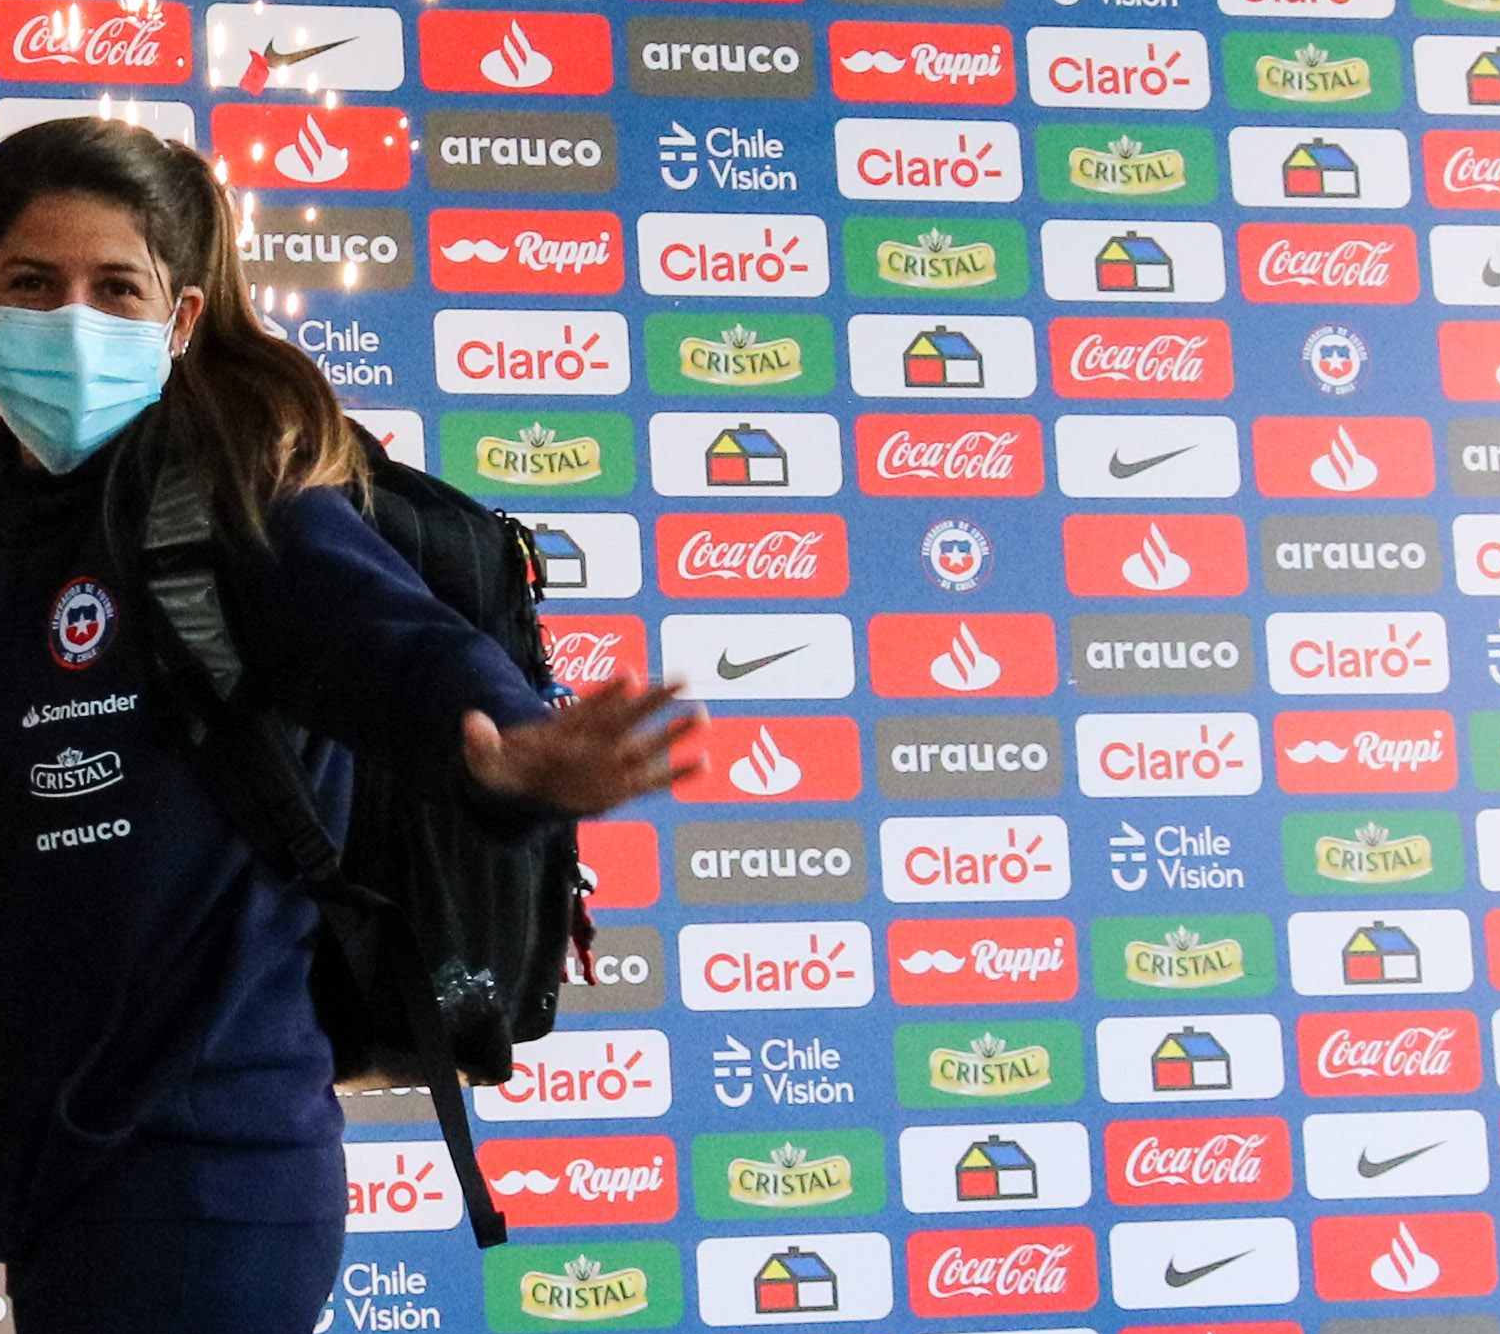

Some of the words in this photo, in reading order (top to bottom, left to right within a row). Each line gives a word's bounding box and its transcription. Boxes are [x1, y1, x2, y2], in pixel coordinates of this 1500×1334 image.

[641, 41, 800, 74] arauco
[910, 42, 1004, 85] Rappi
[1048, 56, 1168, 95] Claro
[1266, 66, 1360, 91] CRISTAL
[440, 135, 602, 168] arauco
[705, 126, 784, 158] Chile
[856, 148, 980, 187] Claro
[1078, 158, 1174, 184] CRISTAL
[514, 230, 612, 273] Rappi
[659, 243, 785, 282] Claro
[887, 252, 985, 277] CRISTAL
[1255, 238, 1397, 288] Coca-Cola
[297, 319, 379, 352] Chile
[456, 340, 585, 379] Claro
[690, 348, 790, 374] CRISTAL
[1067, 333, 1212, 382] Coca-Cola
[486, 447, 589, 473] CRISTAL
[874, 430, 1021, 479] Coca-Cola
[675, 530, 825, 580] Coca-Cola
[1274, 541, 1426, 570] arauco
[1084, 640, 1240, 670] arauco
[1289, 640, 1409, 678] Claro
[41, 693, 138, 724] Santander
[890, 741, 1048, 773] arauco
[1099, 741, 1221, 780] Claro
[1353, 729, 1446, 772] Rappi
[36, 761, 113, 790] CRISTAL
[37, 818, 131, 852] arauco
[1153, 824, 1231, 857] Chile
[689, 846, 851, 879] arauco
[903, 845, 1029, 885] Claro
[1325, 845, 1421, 872] CRISTAL
[703, 951, 831, 993] Claro
[970, 937, 1066, 982] Rappi
[1134, 950, 1232, 977] CRISTAL
[760, 1037, 841, 1071] Chile
[1315, 1026, 1459, 1079] Coca-Cola
[497, 1060, 627, 1103] Claro
[939, 1057, 1039, 1085] CRISTAL
[1123, 1133, 1270, 1187] Coca-Cola
[565, 1156, 665, 1203] Rappi
[738, 1167, 840, 1196] CRISTAL
[346, 1180, 418, 1215] aro
[342, 1260, 427, 1297] Chile
[925, 1242, 1075, 1298] Coca-Cola
[531, 1279, 635, 1309] CRISTAL
